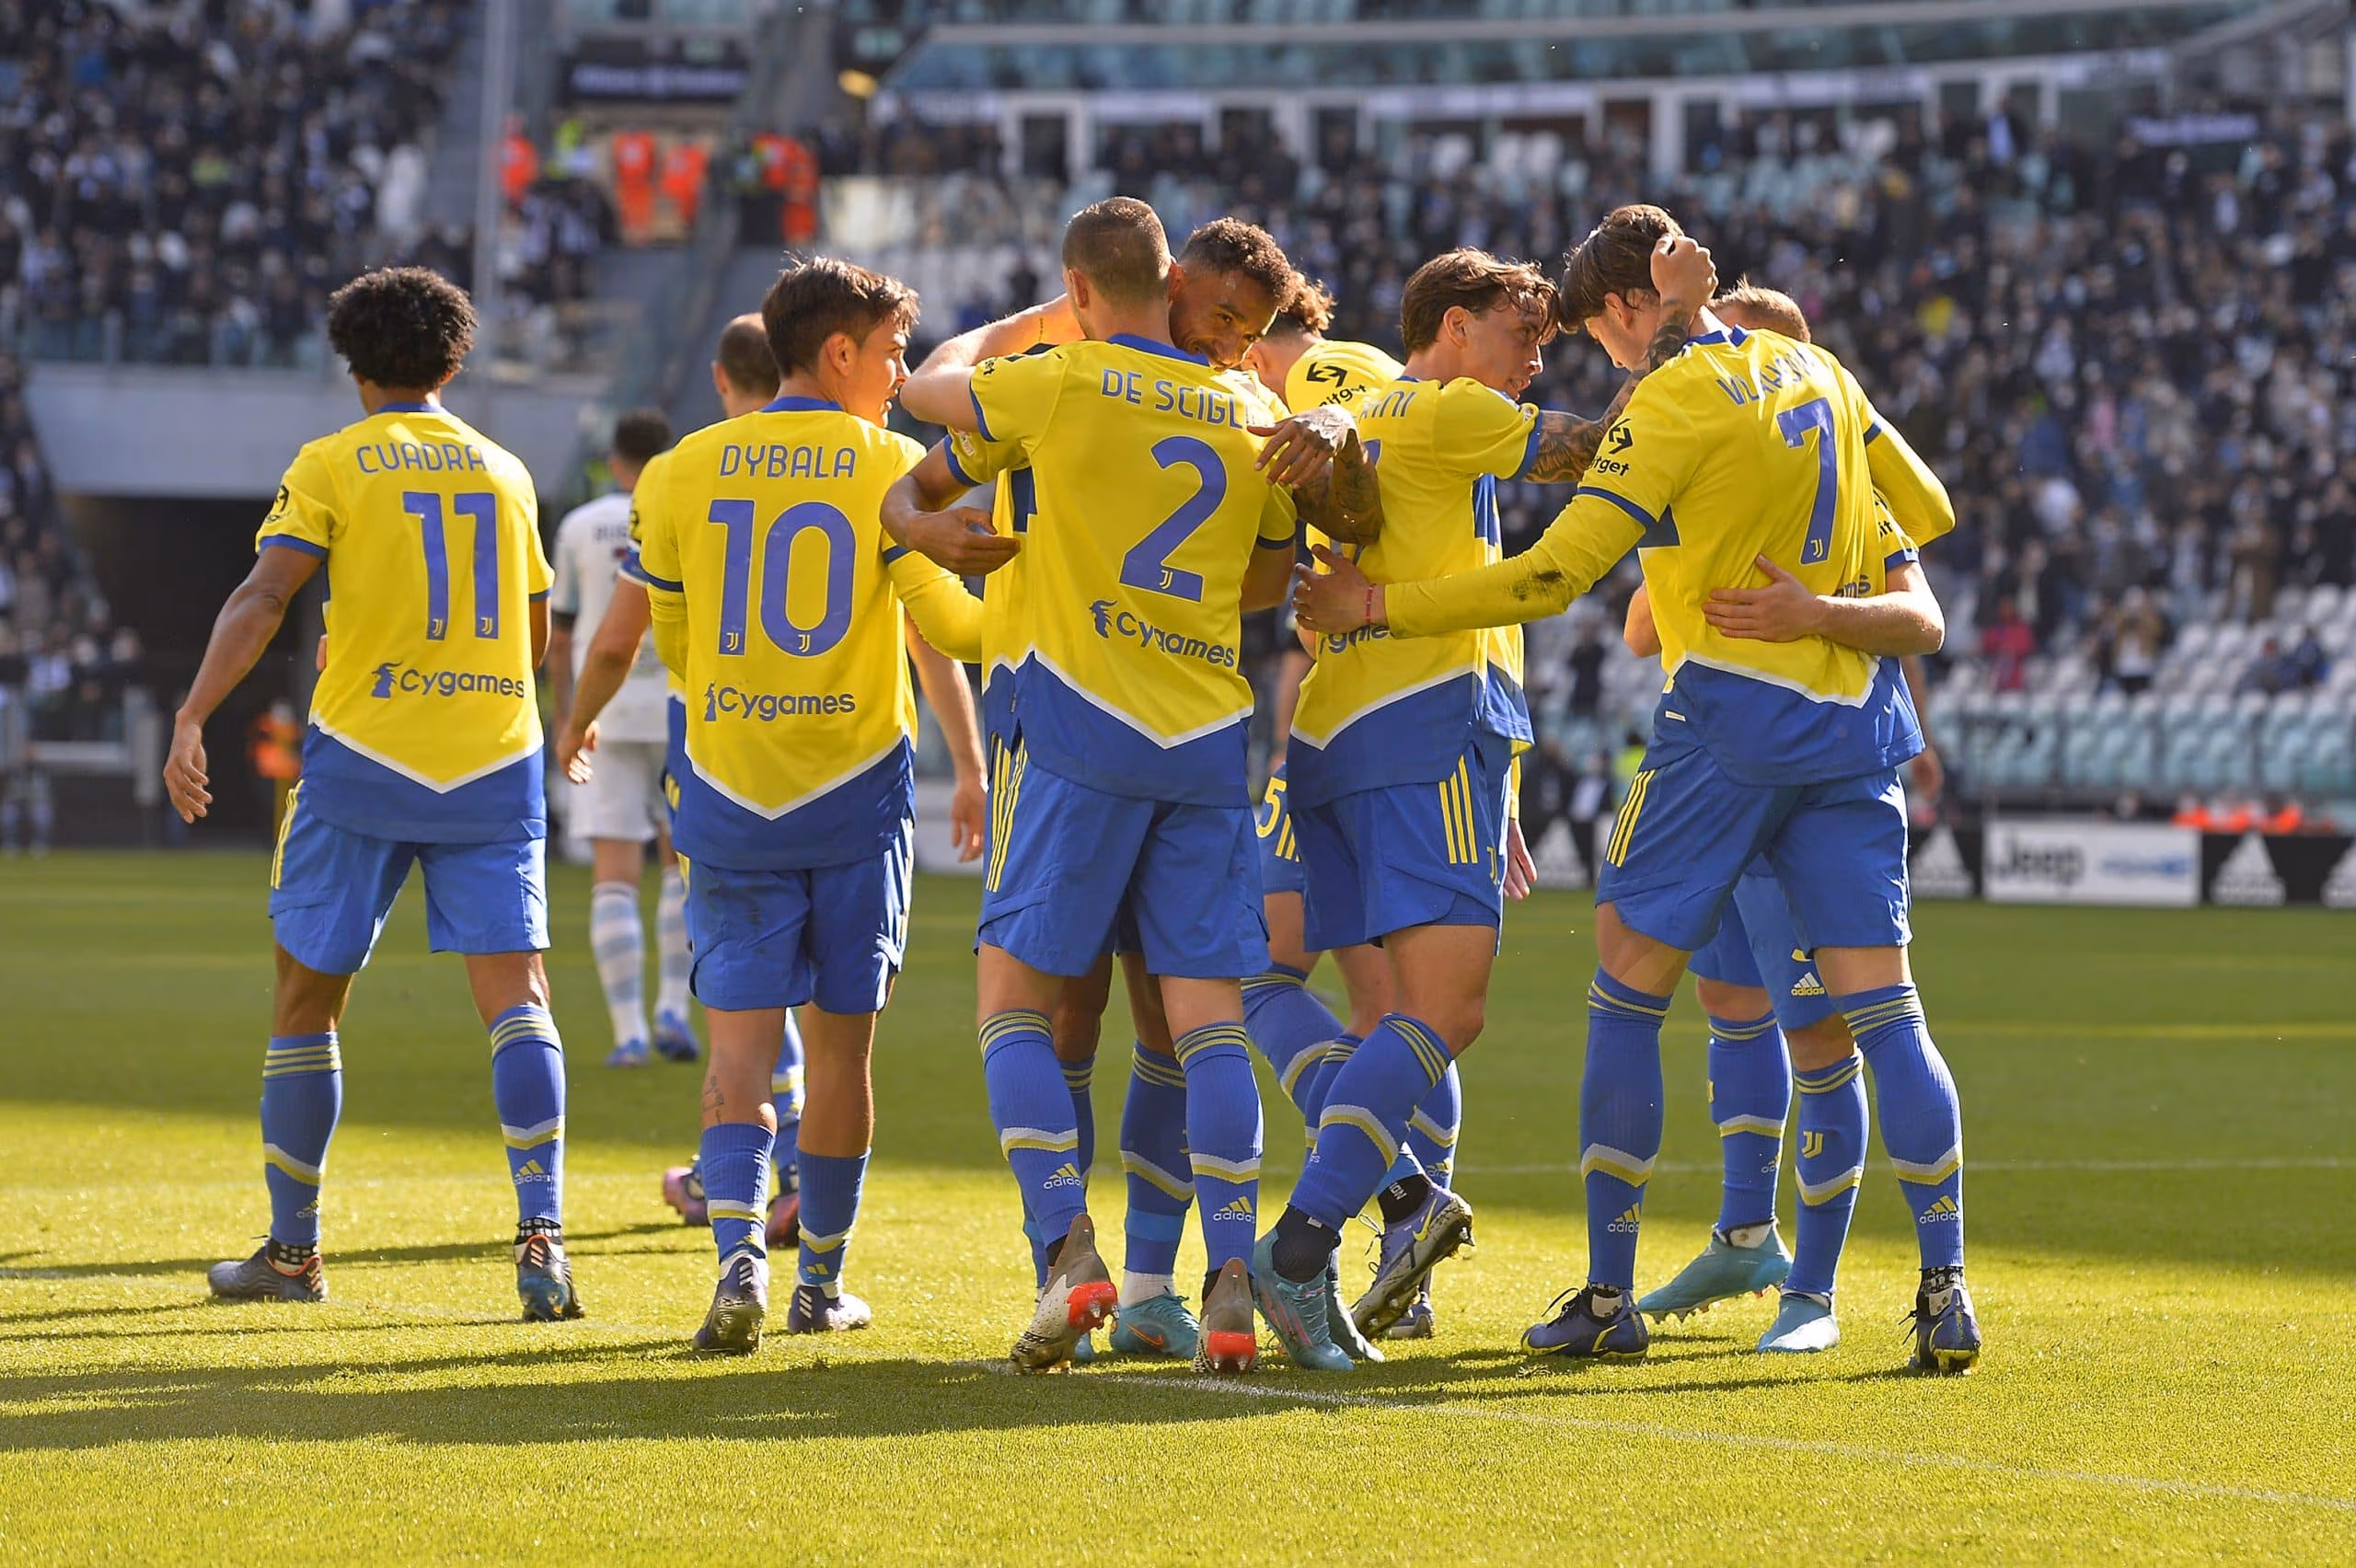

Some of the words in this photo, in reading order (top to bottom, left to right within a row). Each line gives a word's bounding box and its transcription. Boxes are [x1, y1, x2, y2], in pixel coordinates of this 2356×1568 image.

[1102, 368, 1142, 404] DE
[1154, 379, 1250, 430] SCIGL
[356, 442, 488, 474] CUADRA
[719, 444, 857, 478] DYBALA
[1776, 397, 1838, 565] 7
[1118, 435, 1228, 604] 2
[401, 490, 499, 641] 11
[707, 498, 859, 658] 10
[399, 668, 525, 698] Cygames
[718, 686, 856, 722] Cygames
[1256, 776, 1288, 838] 5
[1791, 986, 1826, 996] adidas
